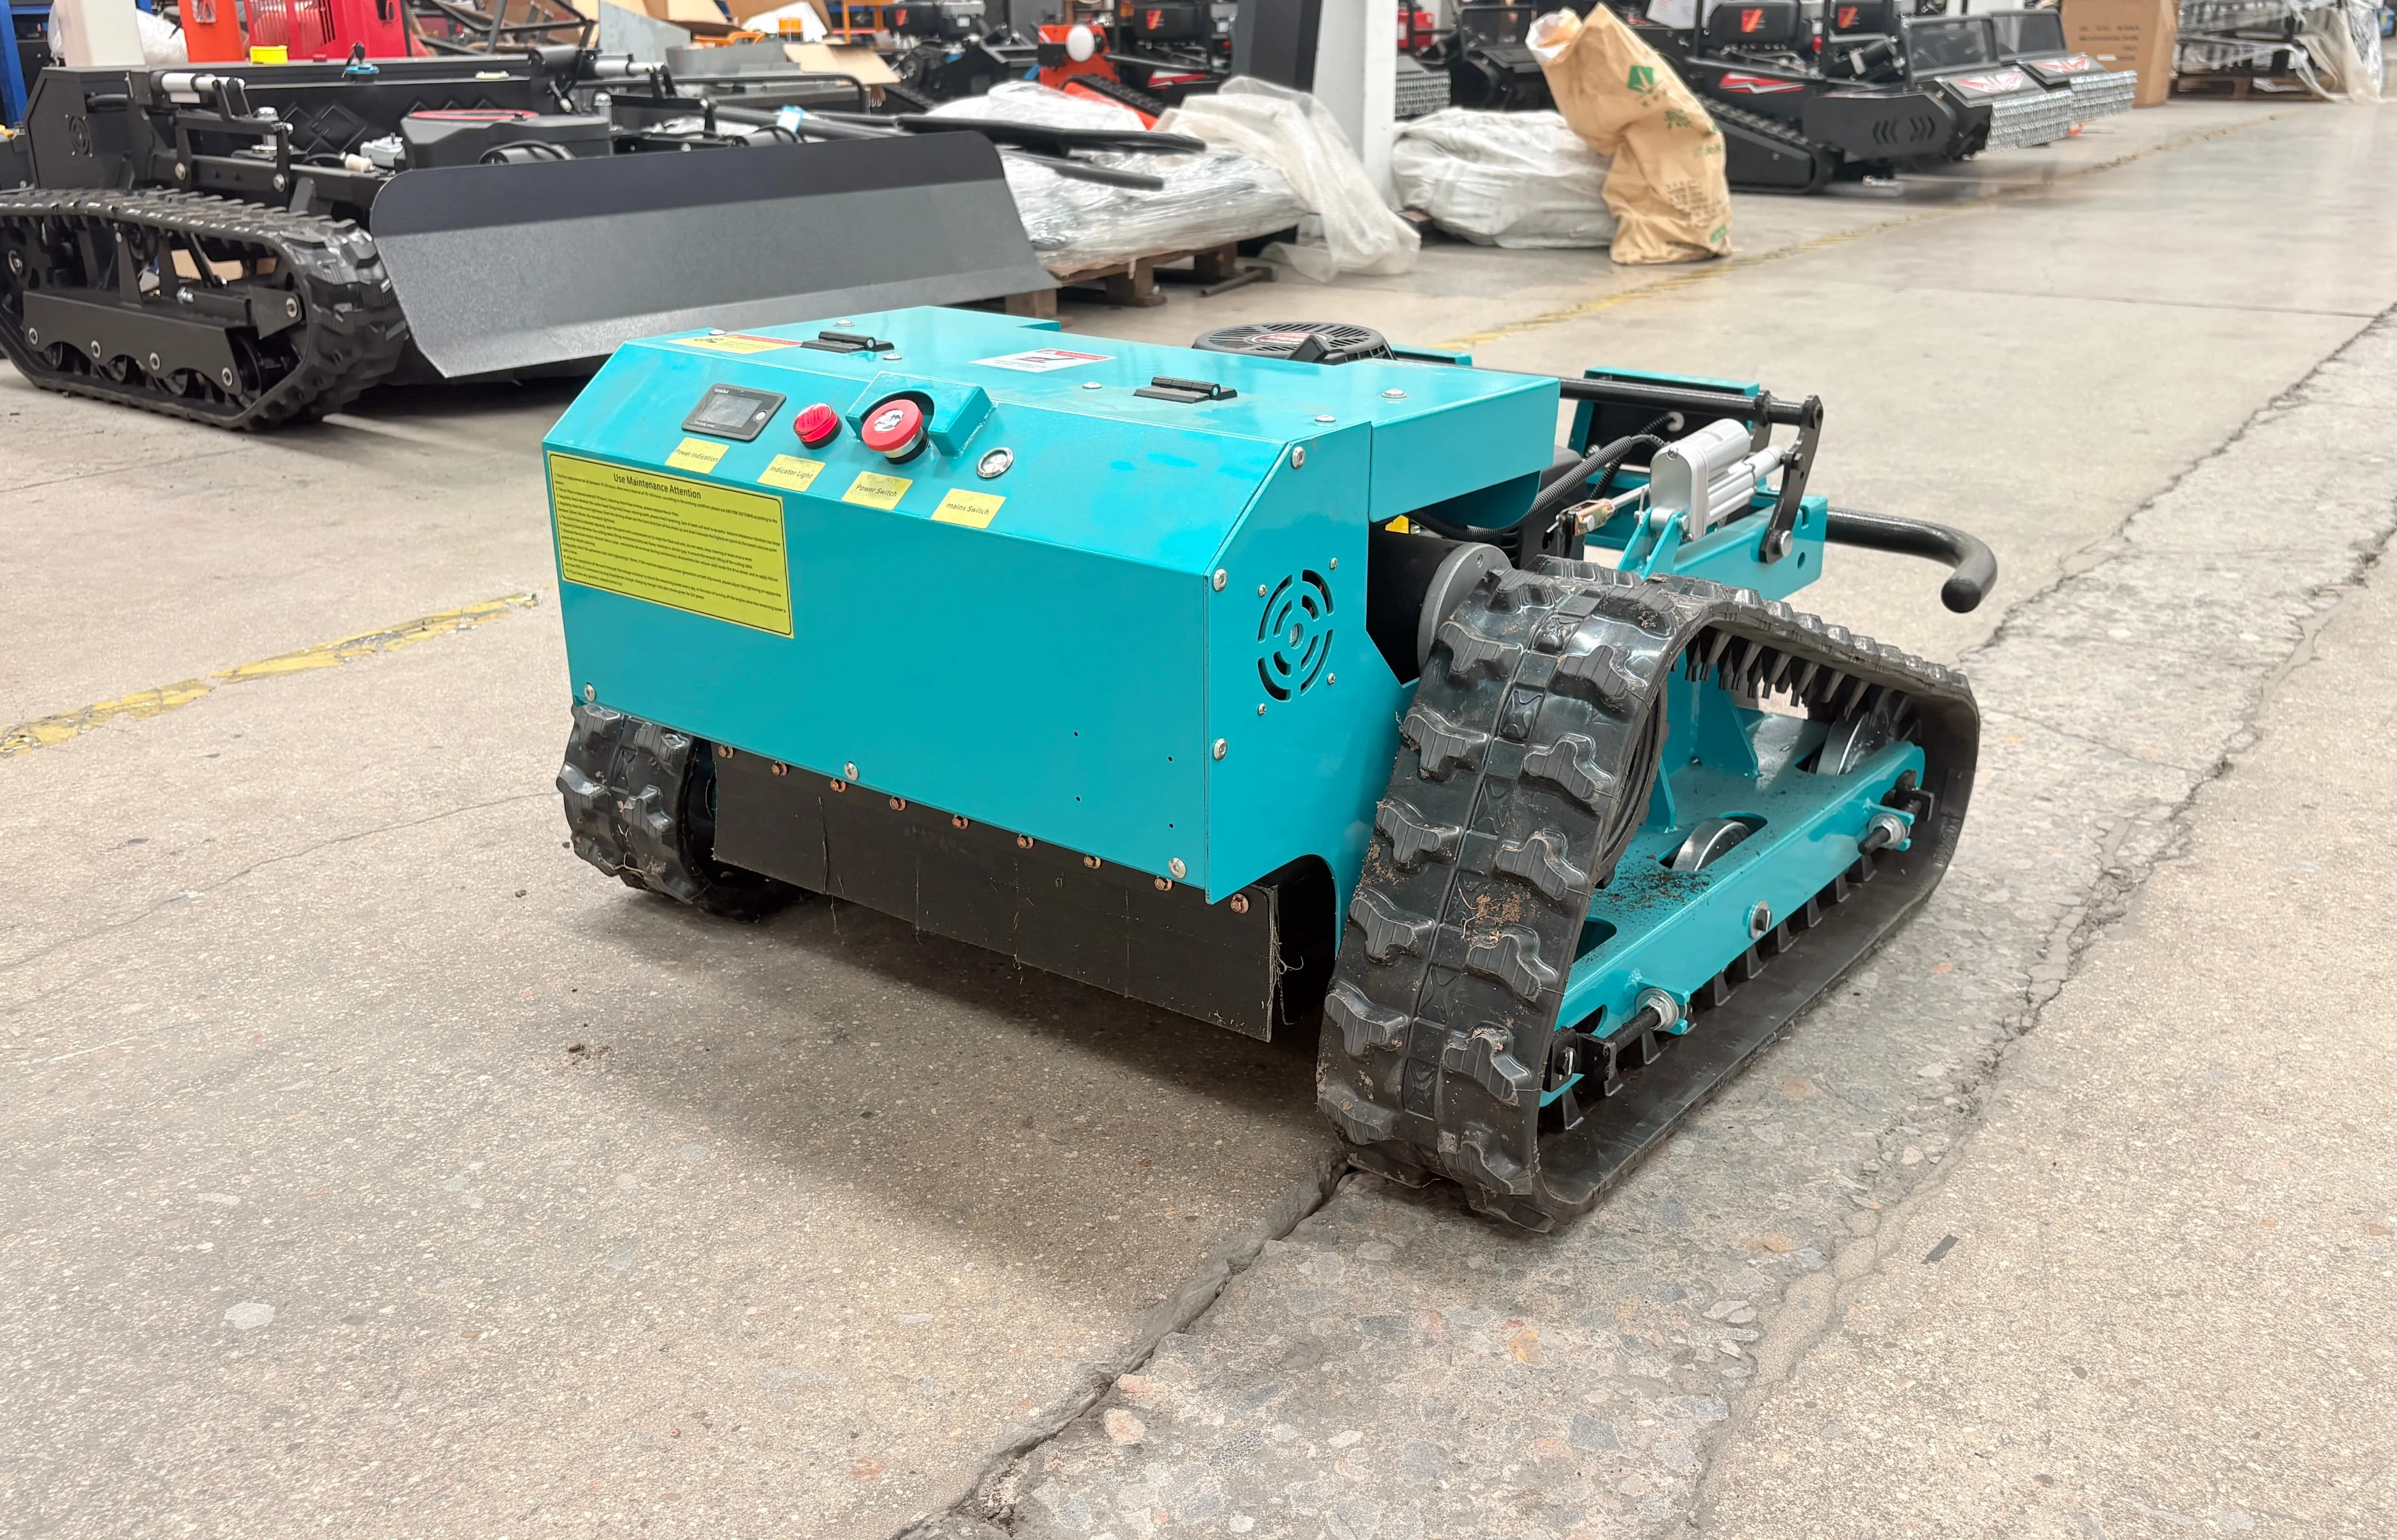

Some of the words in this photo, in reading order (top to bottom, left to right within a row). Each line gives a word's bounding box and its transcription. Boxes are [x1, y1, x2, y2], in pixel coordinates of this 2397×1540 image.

[675, 449, 691, 457] Power
[691, 452, 718, 462] Indication
[770, 466, 796, 475] Indicator
[796, 471, 813, 479] Light
[613, 473, 626, 484] Use
[626, 476, 668, 493] Maintenance
[670, 485, 701, 499] Attention
[856, 484, 875, 493] Power
[875, 488, 897, 497] Switch
[966, 506, 989, 515] Switch
